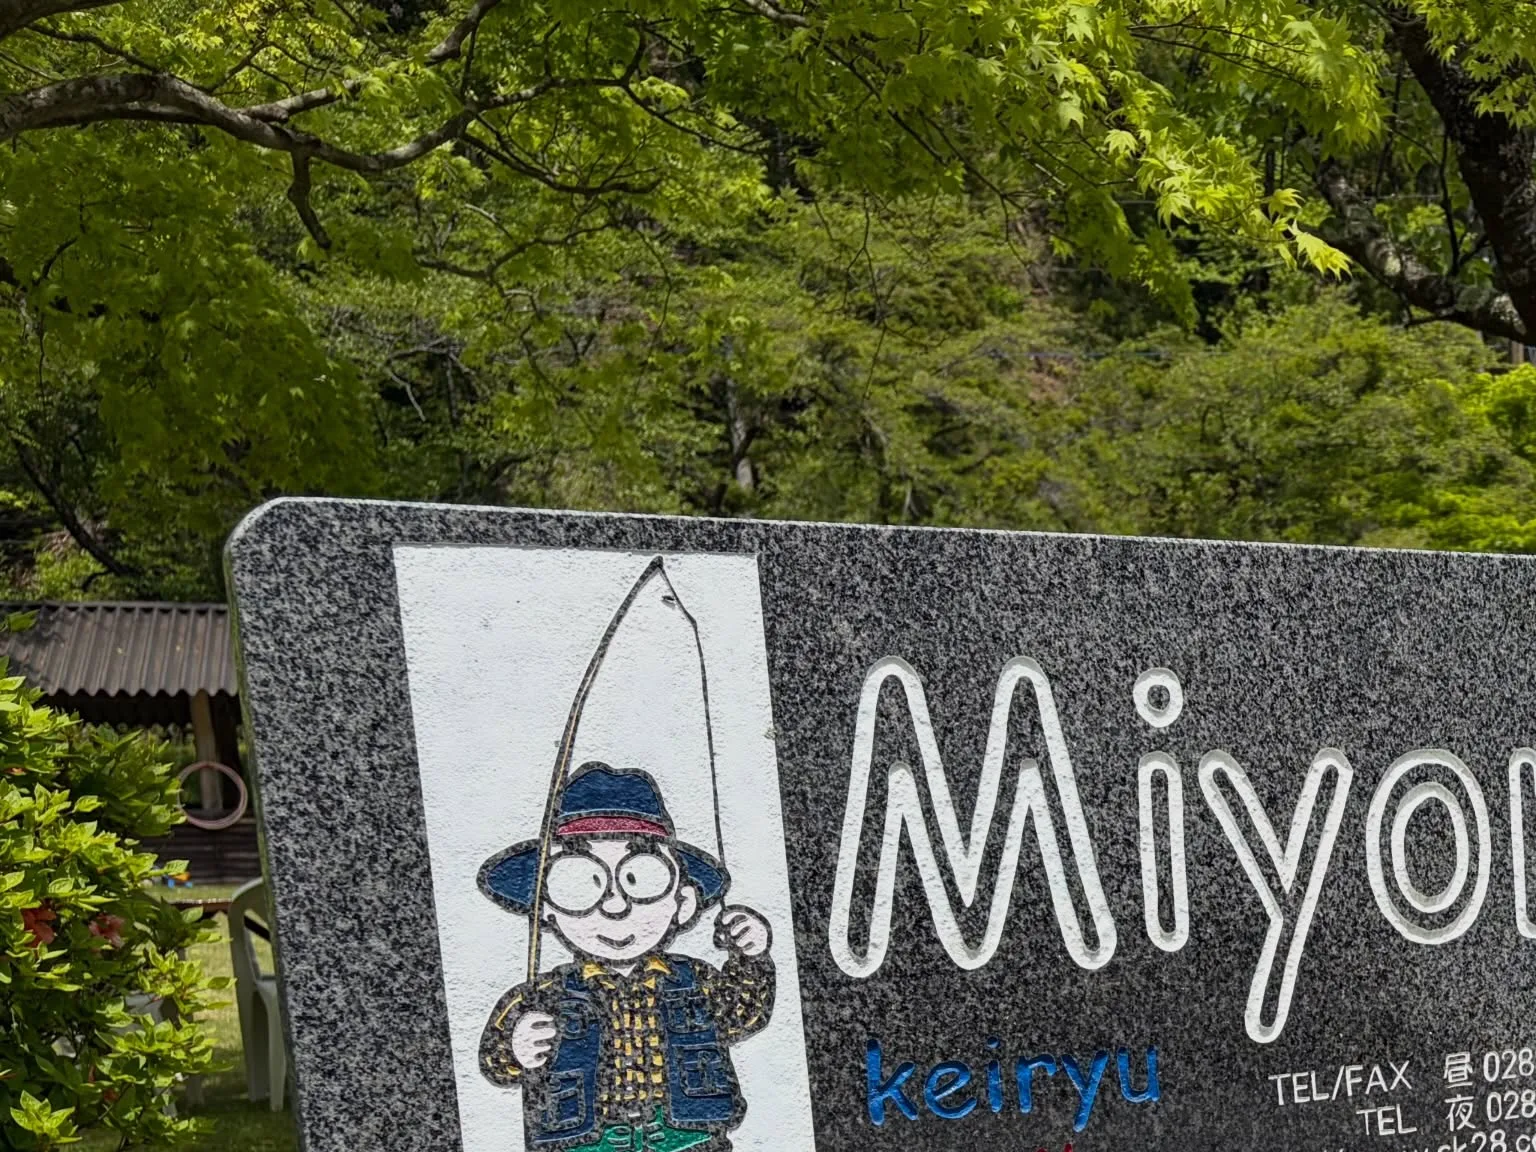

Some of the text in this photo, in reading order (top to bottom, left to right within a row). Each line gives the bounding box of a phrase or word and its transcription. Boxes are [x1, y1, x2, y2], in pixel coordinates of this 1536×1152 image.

[865, 1036, 1161, 1133] keiryu
[1267, 1059, 1413, 1107] TEL/FAX
[1356, 1104, 1418, 1137] TEL
[1444, 1093, 1477, 1134] 夜
